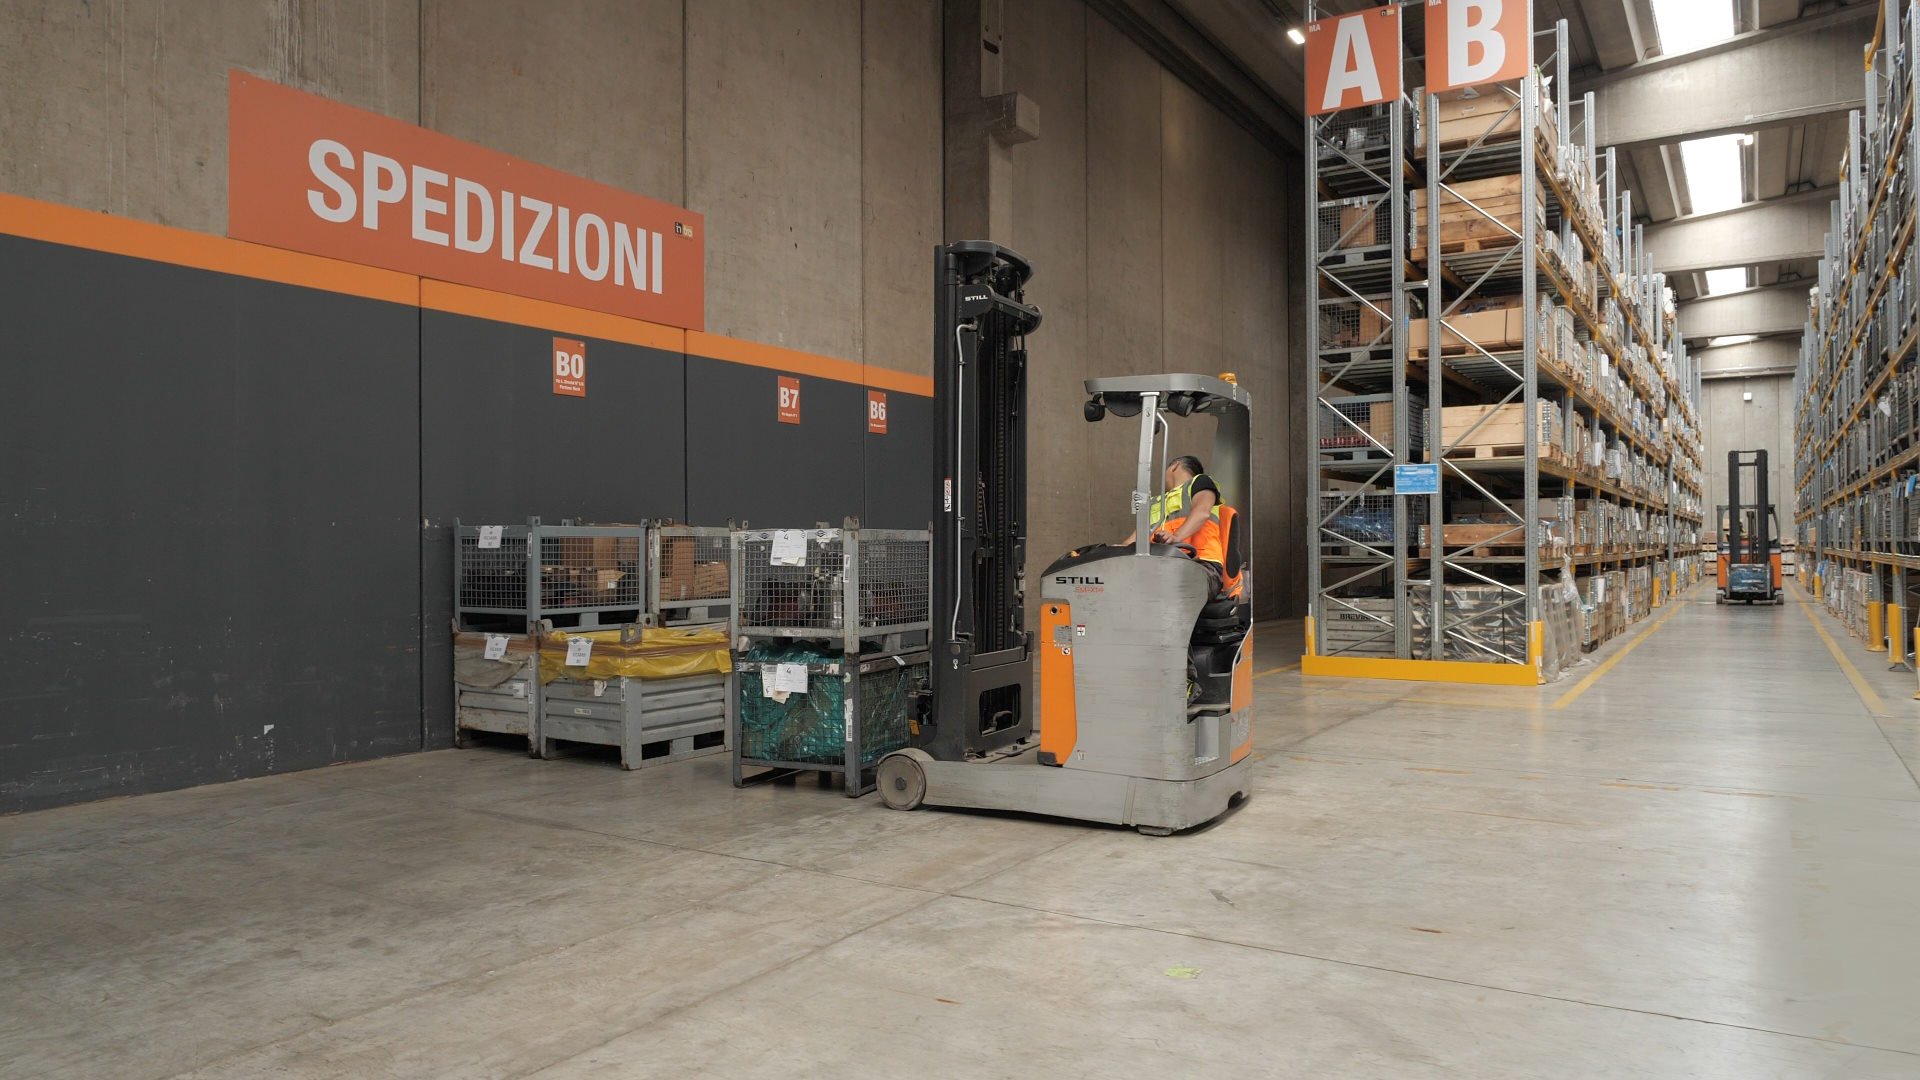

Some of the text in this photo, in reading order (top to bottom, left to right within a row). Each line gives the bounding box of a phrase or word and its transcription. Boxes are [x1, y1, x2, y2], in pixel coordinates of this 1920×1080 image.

[1309, 23, 1321, 32] MA
[1447, 0, 1506, 87] B
[1322, 14, 1383, 110] A
[306, 138, 663, 295] SPEDIZIONI
[780, 387, 799, 409] B7
[870, 400, 886, 421] B6
[1056, 576, 1104, 584] STILL
